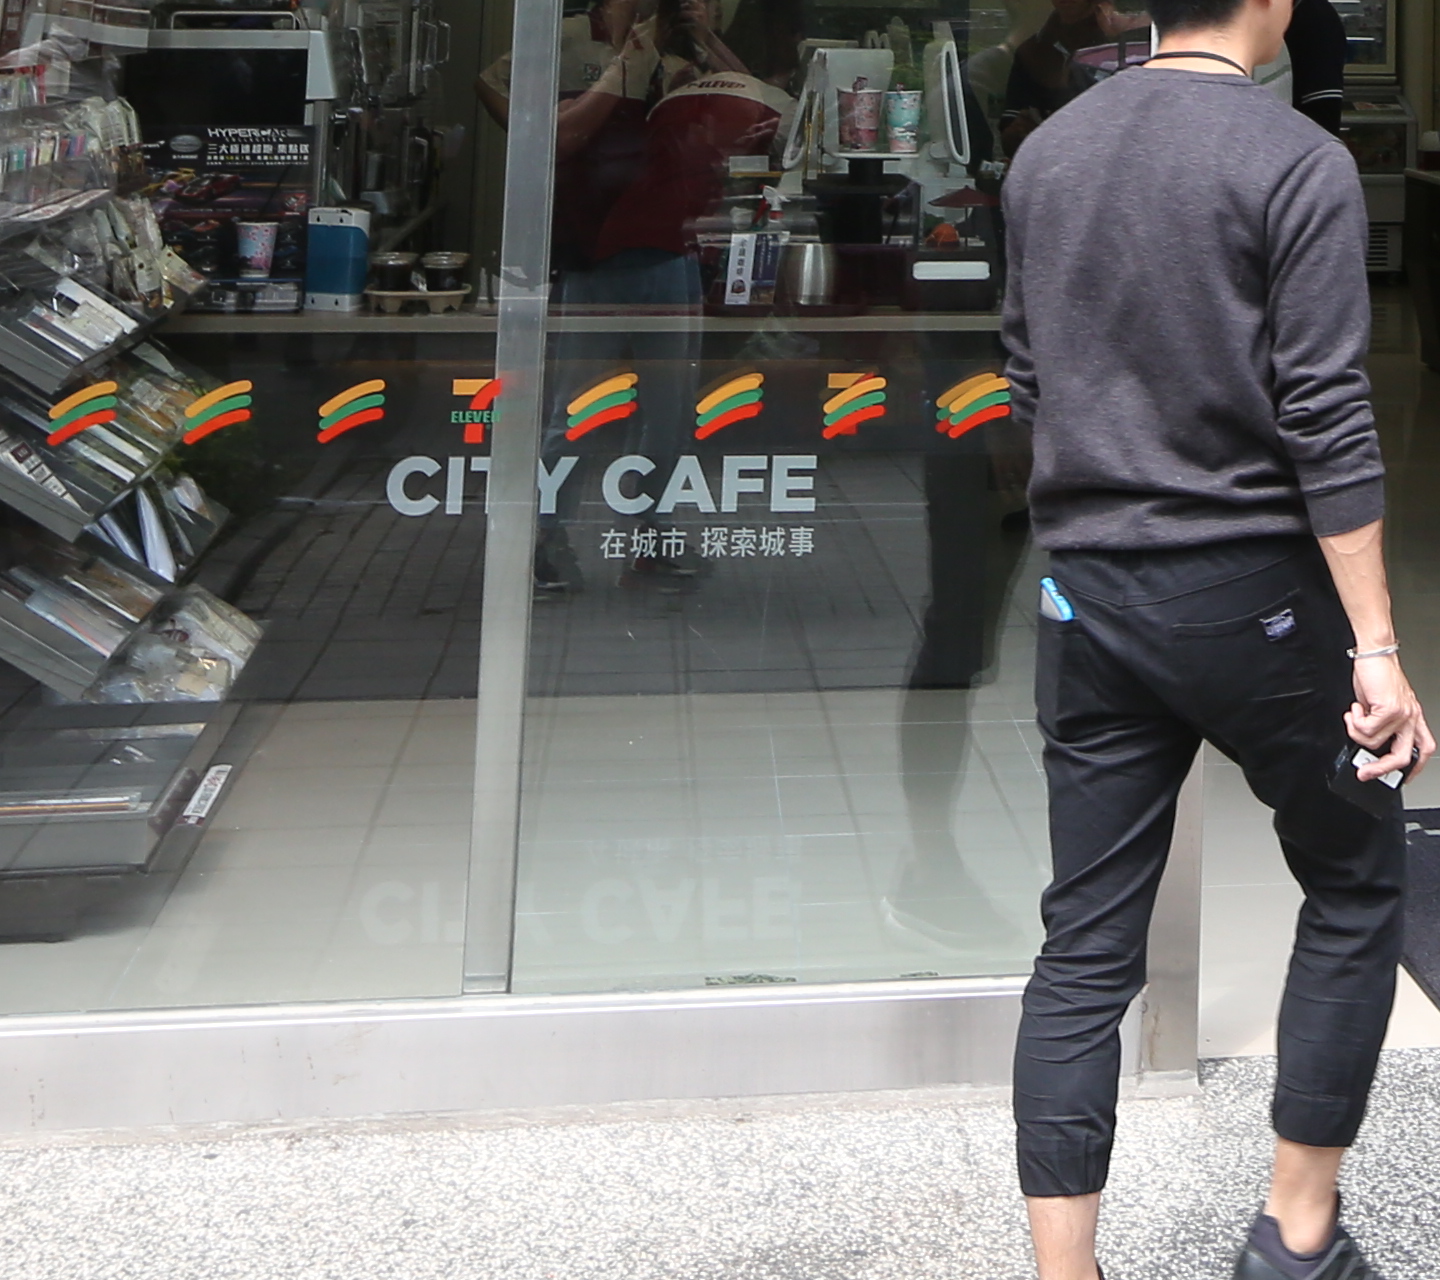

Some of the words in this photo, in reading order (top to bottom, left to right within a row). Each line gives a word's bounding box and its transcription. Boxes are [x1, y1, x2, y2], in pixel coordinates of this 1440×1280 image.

[601, 454, 818, 516] CAFE
[600, 526, 688, 560] 在城市
[700, 525, 816, 559] 探索城事
